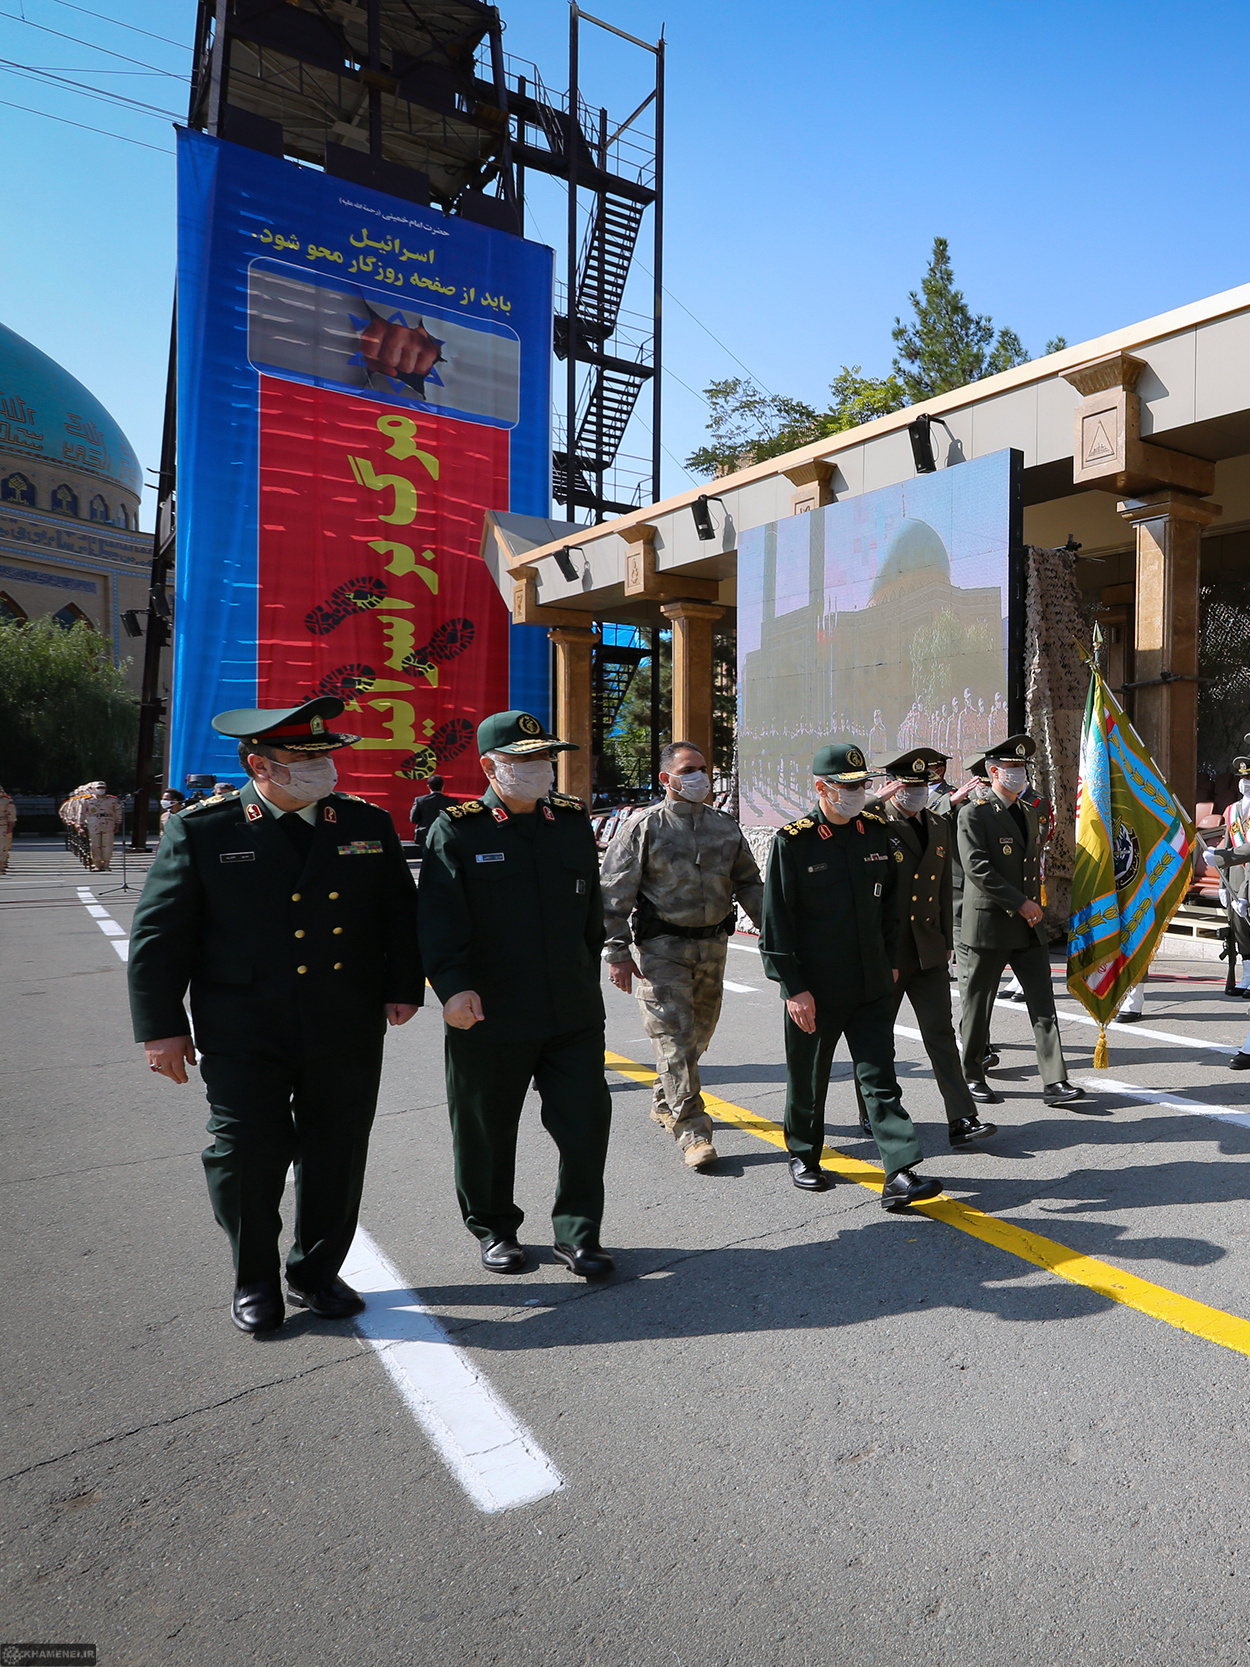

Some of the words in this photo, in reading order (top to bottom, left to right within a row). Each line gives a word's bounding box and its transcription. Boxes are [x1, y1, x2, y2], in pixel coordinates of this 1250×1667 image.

[382, 212, 409, 223] خمینی
[408, 219, 424, 228] امام
[251, 228, 300, 251] شود.
[423, 223, 450, 236] حضرت
[305, 243, 344, 264] محو
[349, 228, 435, 264] اسرائیل
[347, 255, 405, 286] روزگار
[409, 272, 456, 296] صفحه
[459, 287, 475, 305] از
[480, 292, 512, 316] باید
[346, 414, 440, 526] مرگ
[367, 540, 439, 596] بر
